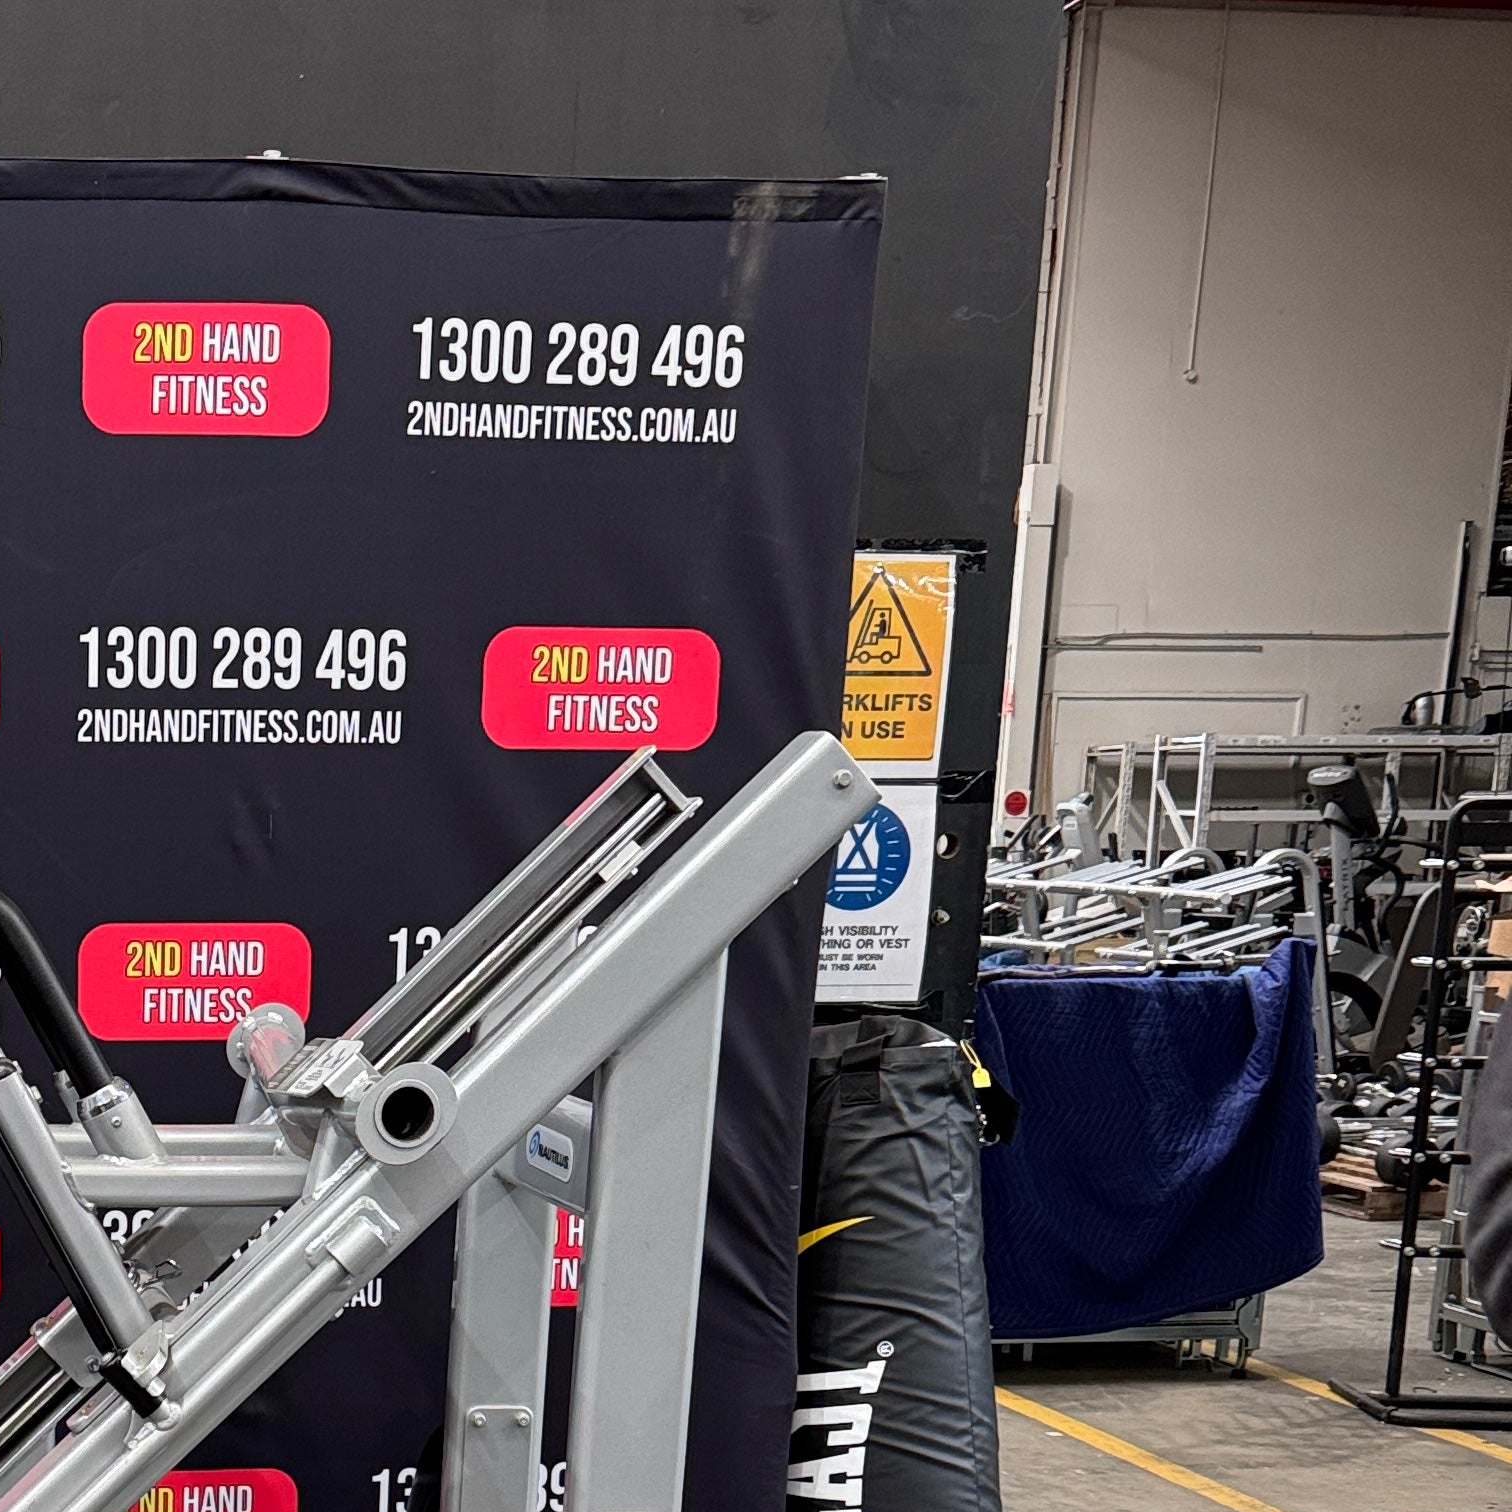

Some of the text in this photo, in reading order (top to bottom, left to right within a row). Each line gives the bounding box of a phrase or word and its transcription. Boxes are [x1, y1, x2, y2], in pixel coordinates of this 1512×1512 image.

[135, 323, 280, 362] 2ND HAND
[413, 317, 744, 388] 1300 289 496
[153, 376, 267, 415] FITNESS
[407, 401, 736, 443] 2NDHANDFITNESS.COM.AU
[80, 626, 406, 690] 1300 289 496
[533, 646, 672, 683] 2ND HAND
[78, 709, 401, 744] 2NDHANDFITNESS.COM.AU
[548, 695, 658, 731] FITNESS
[861, 721, 906, 739] USE
[820, 938, 911, 949] HING OR VEST
[838, 925, 899, 936] VISIBILITY
[127, 942, 263, 976] 2ND HAND
[144, 988, 252, 1023] FITNESS
[538, 1144, 569, 1169] NAUTILUS
